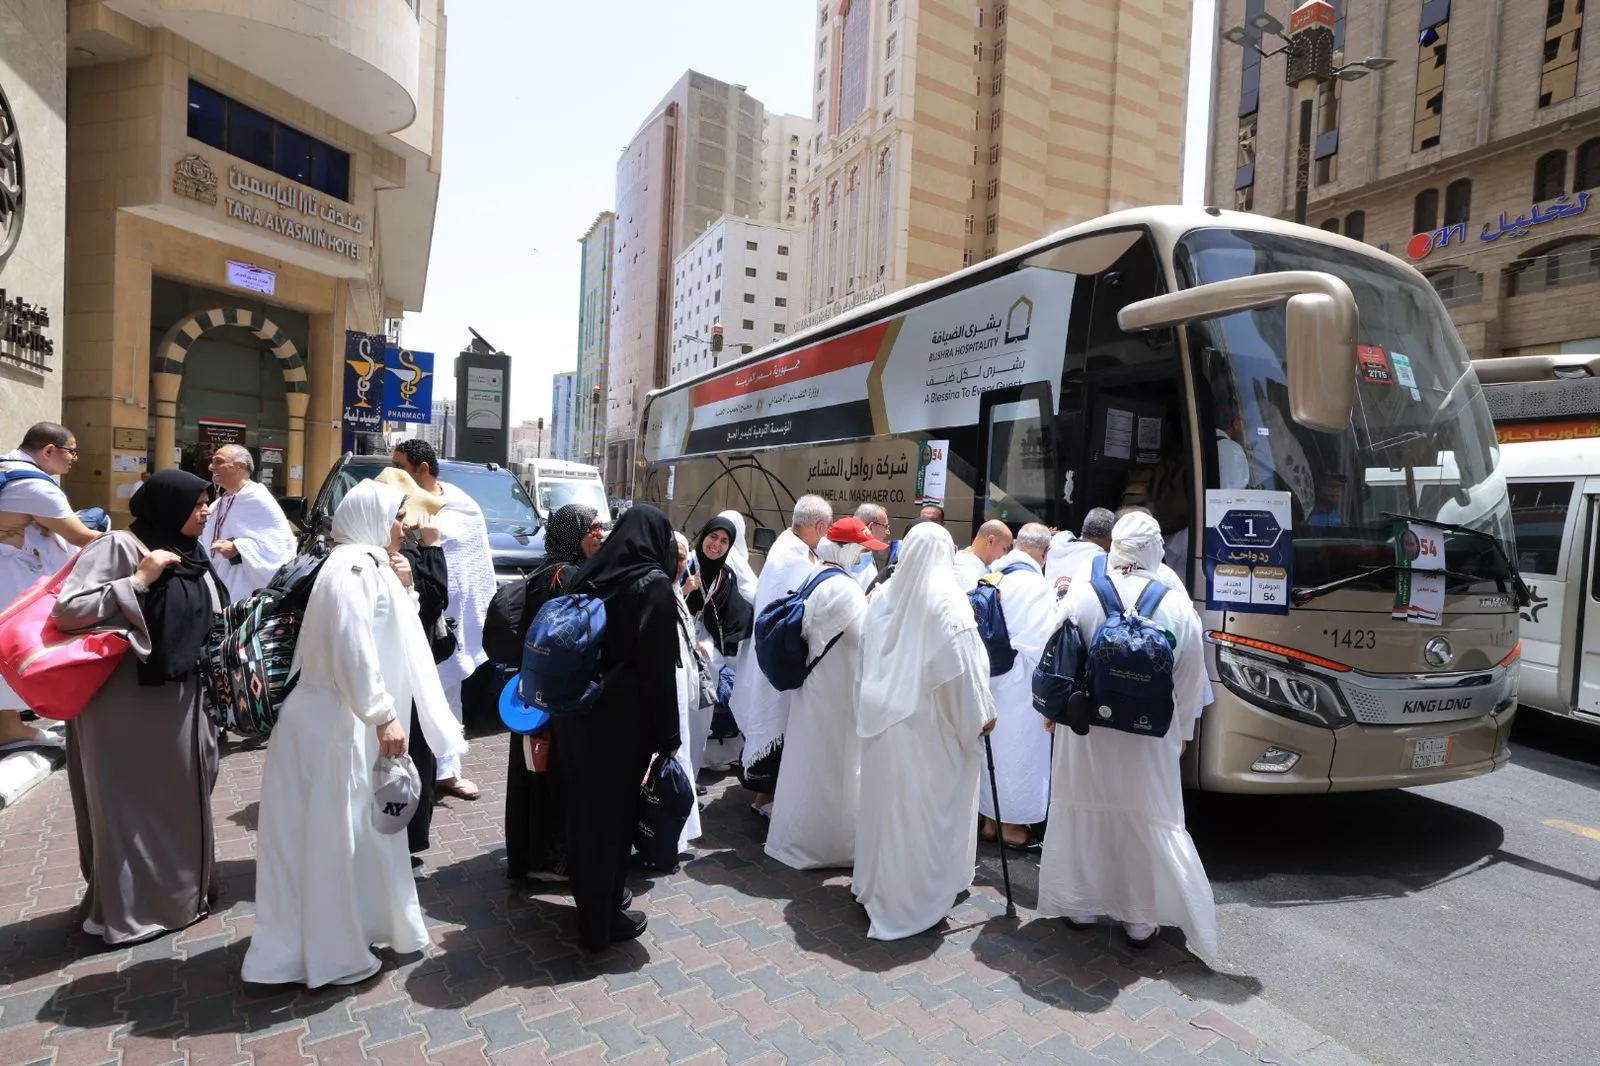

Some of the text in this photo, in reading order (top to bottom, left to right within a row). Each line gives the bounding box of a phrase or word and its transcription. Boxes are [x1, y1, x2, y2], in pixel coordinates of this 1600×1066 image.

[228, 166, 298, 210] الياسمين
[299, 192, 318, 217] تارا
[225, 197, 362, 260] TARA ALYASMIN HOTEL
[320, 204, 363, 234] فندق
[931, 313, 1002, 346] بشرى الضيافة
[928, 337, 1000, 362] BUSHRA HOSPITALITY
[926, 357, 1025, 387] بشرى لكل ضيف
[961, 387, 971, 399] To
[343, 406, 381, 427] صيدلية
[387, 410, 426, 420] PHARMACY
[932, 449, 943, 461] 54
[807, 453, 909, 481] شركة رواحل المشاعر
[838, 489, 848, 501] AL
[849, 489, 889, 502] MASHAER
[889, 488, 906, 503] CO.
[1244, 518, 1257, 537] 1
[1227, 551, 1269, 562] رد واحد
[1420, 538, 1437, 558] 54
[1263, 592, 1276, 602] 56
[1402, 697, 1473, 713] KING LONG
